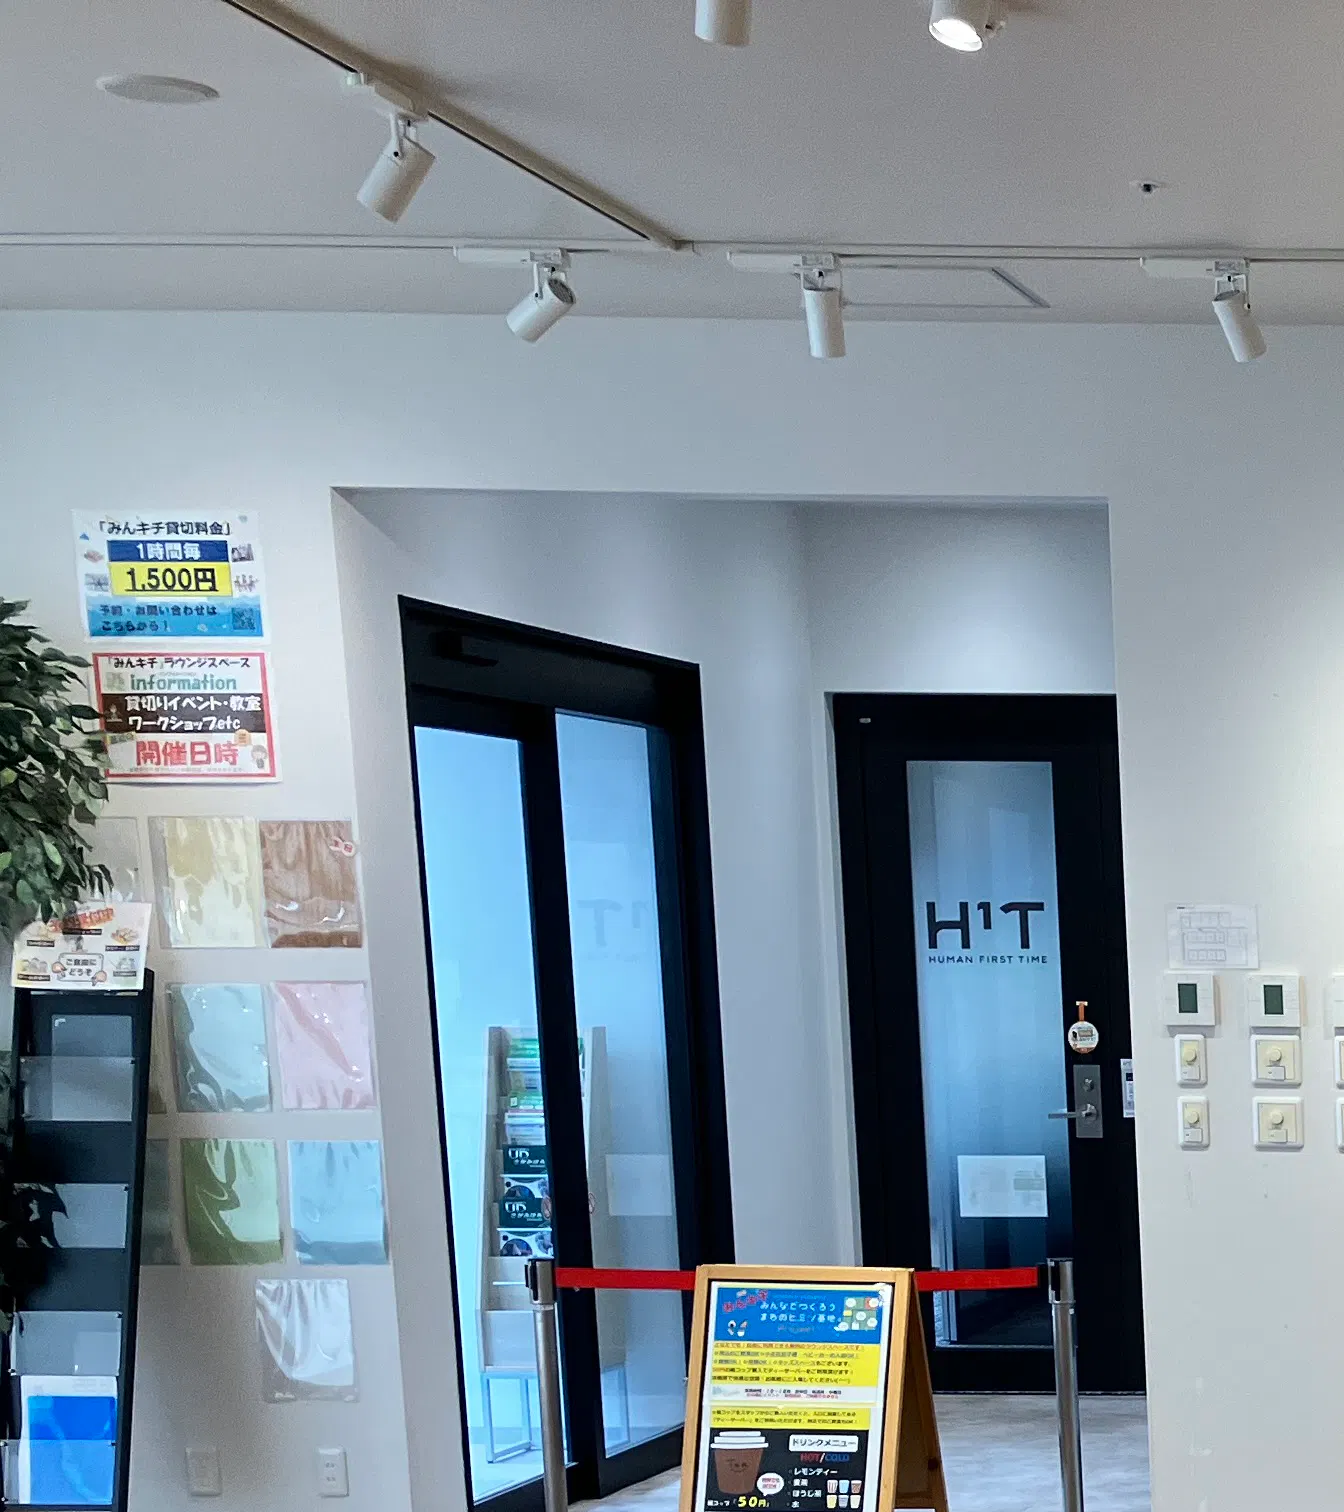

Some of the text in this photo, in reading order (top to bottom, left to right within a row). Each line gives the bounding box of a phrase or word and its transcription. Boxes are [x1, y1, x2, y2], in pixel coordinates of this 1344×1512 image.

[136, 542, 201, 560] 1時間毎
[130, 674, 237, 691] information
[125, 695, 261, 712] 貸切りイベント・教室
[135, 740, 239, 767] 開催日時
[928, 955, 1048, 964] HUMAN FIRST TIME
[792, 1438, 856, 1447] ドリンクメニュー
